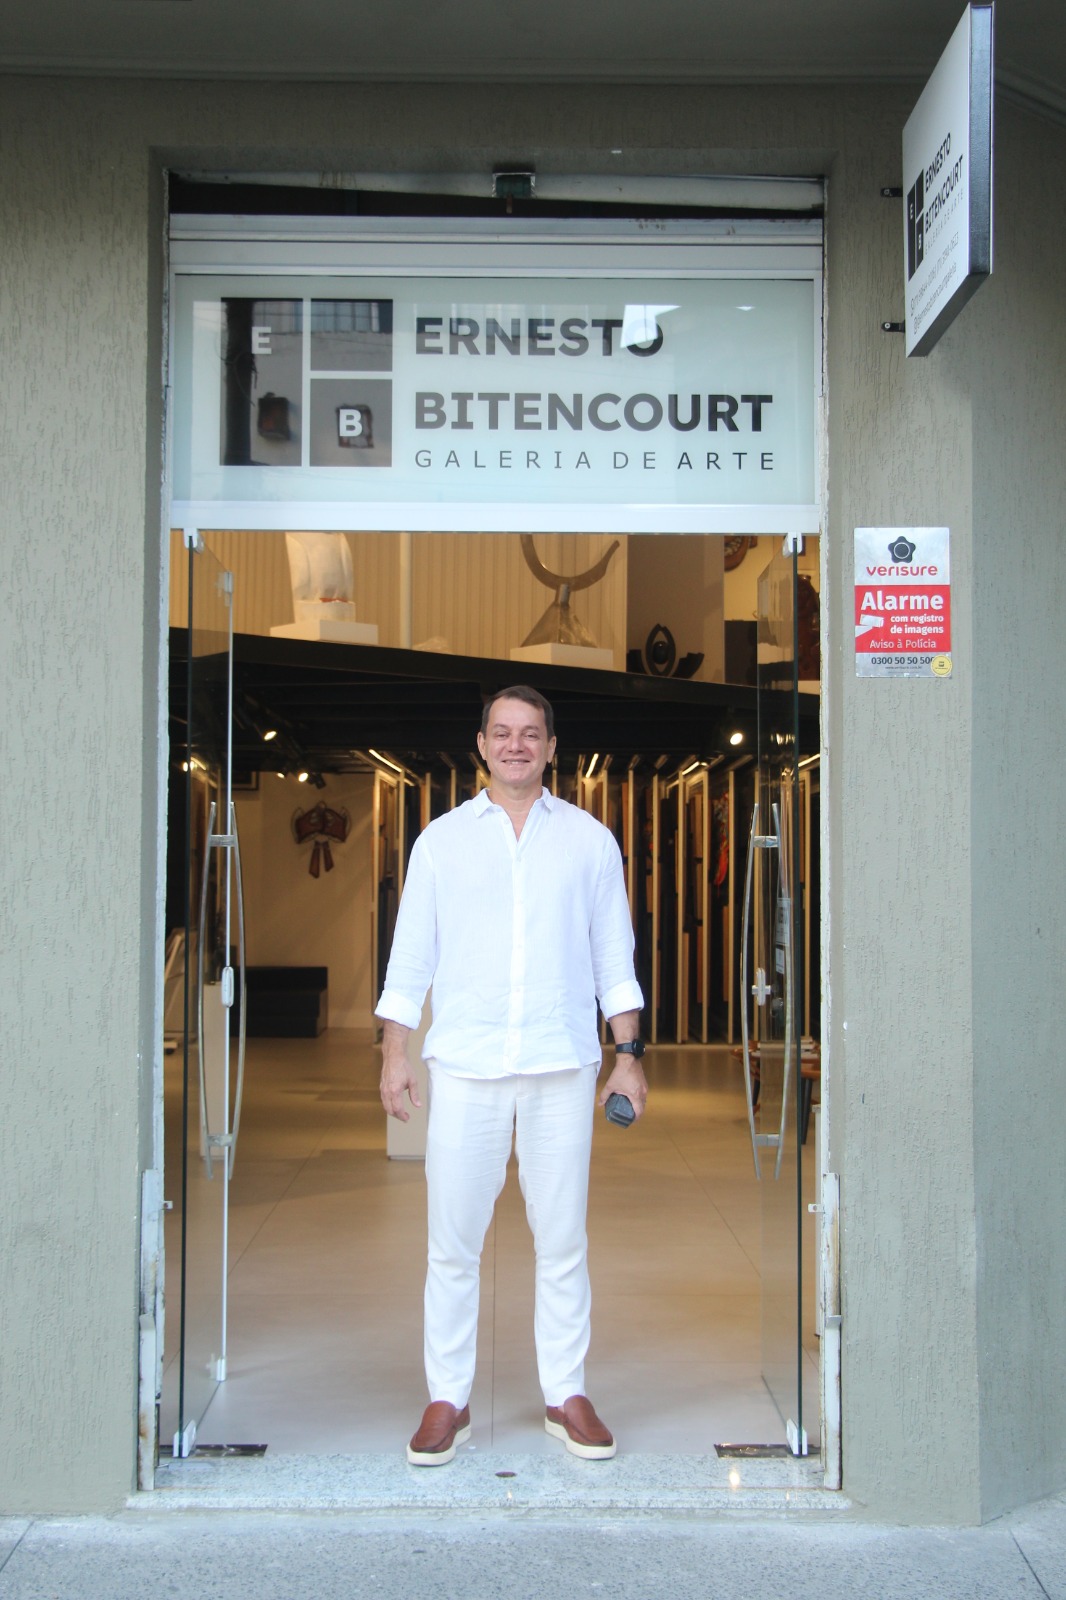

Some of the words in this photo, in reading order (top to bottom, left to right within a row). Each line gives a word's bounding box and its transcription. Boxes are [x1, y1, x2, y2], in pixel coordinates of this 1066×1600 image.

[925, 132, 951, 193] ERNESTO
[925, 154, 963, 233] BITENCOURT
[909, 203, 914, 220] E
[251, 326, 272, 355] E
[415, 317, 664, 358] ERNESTO
[338, 408, 363, 437] B
[415, 392, 773, 433] BITENCOURT
[415, 449, 592, 470] GALERIA
[612, 450, 656, 470] DE
[676, 451, 774, 471] ARTE
[866, 565, 938, 577] verisure
[860, 590, 944, 611] Alarme
[890, 615, 909, 623] com
[910, 613, 944, 624] registro
[890, 624, 902, 634] de
[904, 624, 944, 636] imagens
[869, 639, 894, 649] Aviso
[896, 639, 903, 649] à
[905, 639, 937, 649] Polícia
[871, 656, 892, 665] 0300
[894, 656, 905, 665] 50
[907, 656, 918, 665] 50
